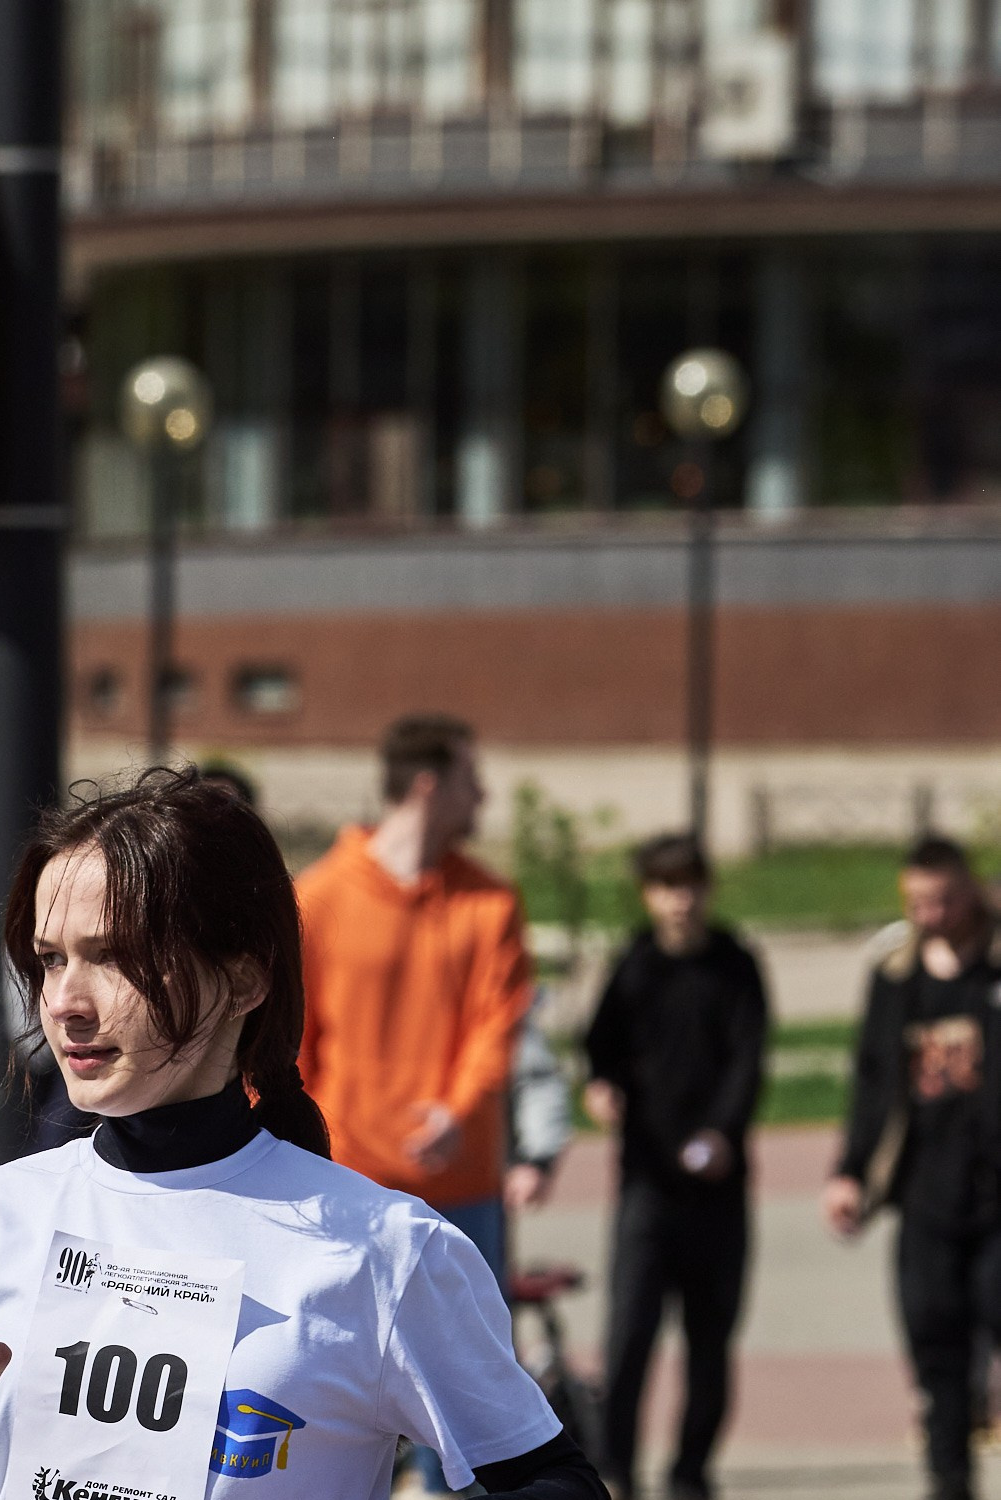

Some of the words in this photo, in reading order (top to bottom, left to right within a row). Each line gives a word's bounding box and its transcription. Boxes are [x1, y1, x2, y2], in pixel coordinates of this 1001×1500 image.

[56, 1247, 87, 1286] 90
[181, 1281, 218, 1291] ЭСТАФЕТА
[173, 1290, 215, 1303] КРАЙ»
[55, 1340, 188, 1432] 100
[84, 1480, 108, 1491] ДОМ
[112, 1485, 153, 1499] РЕМОНТ
